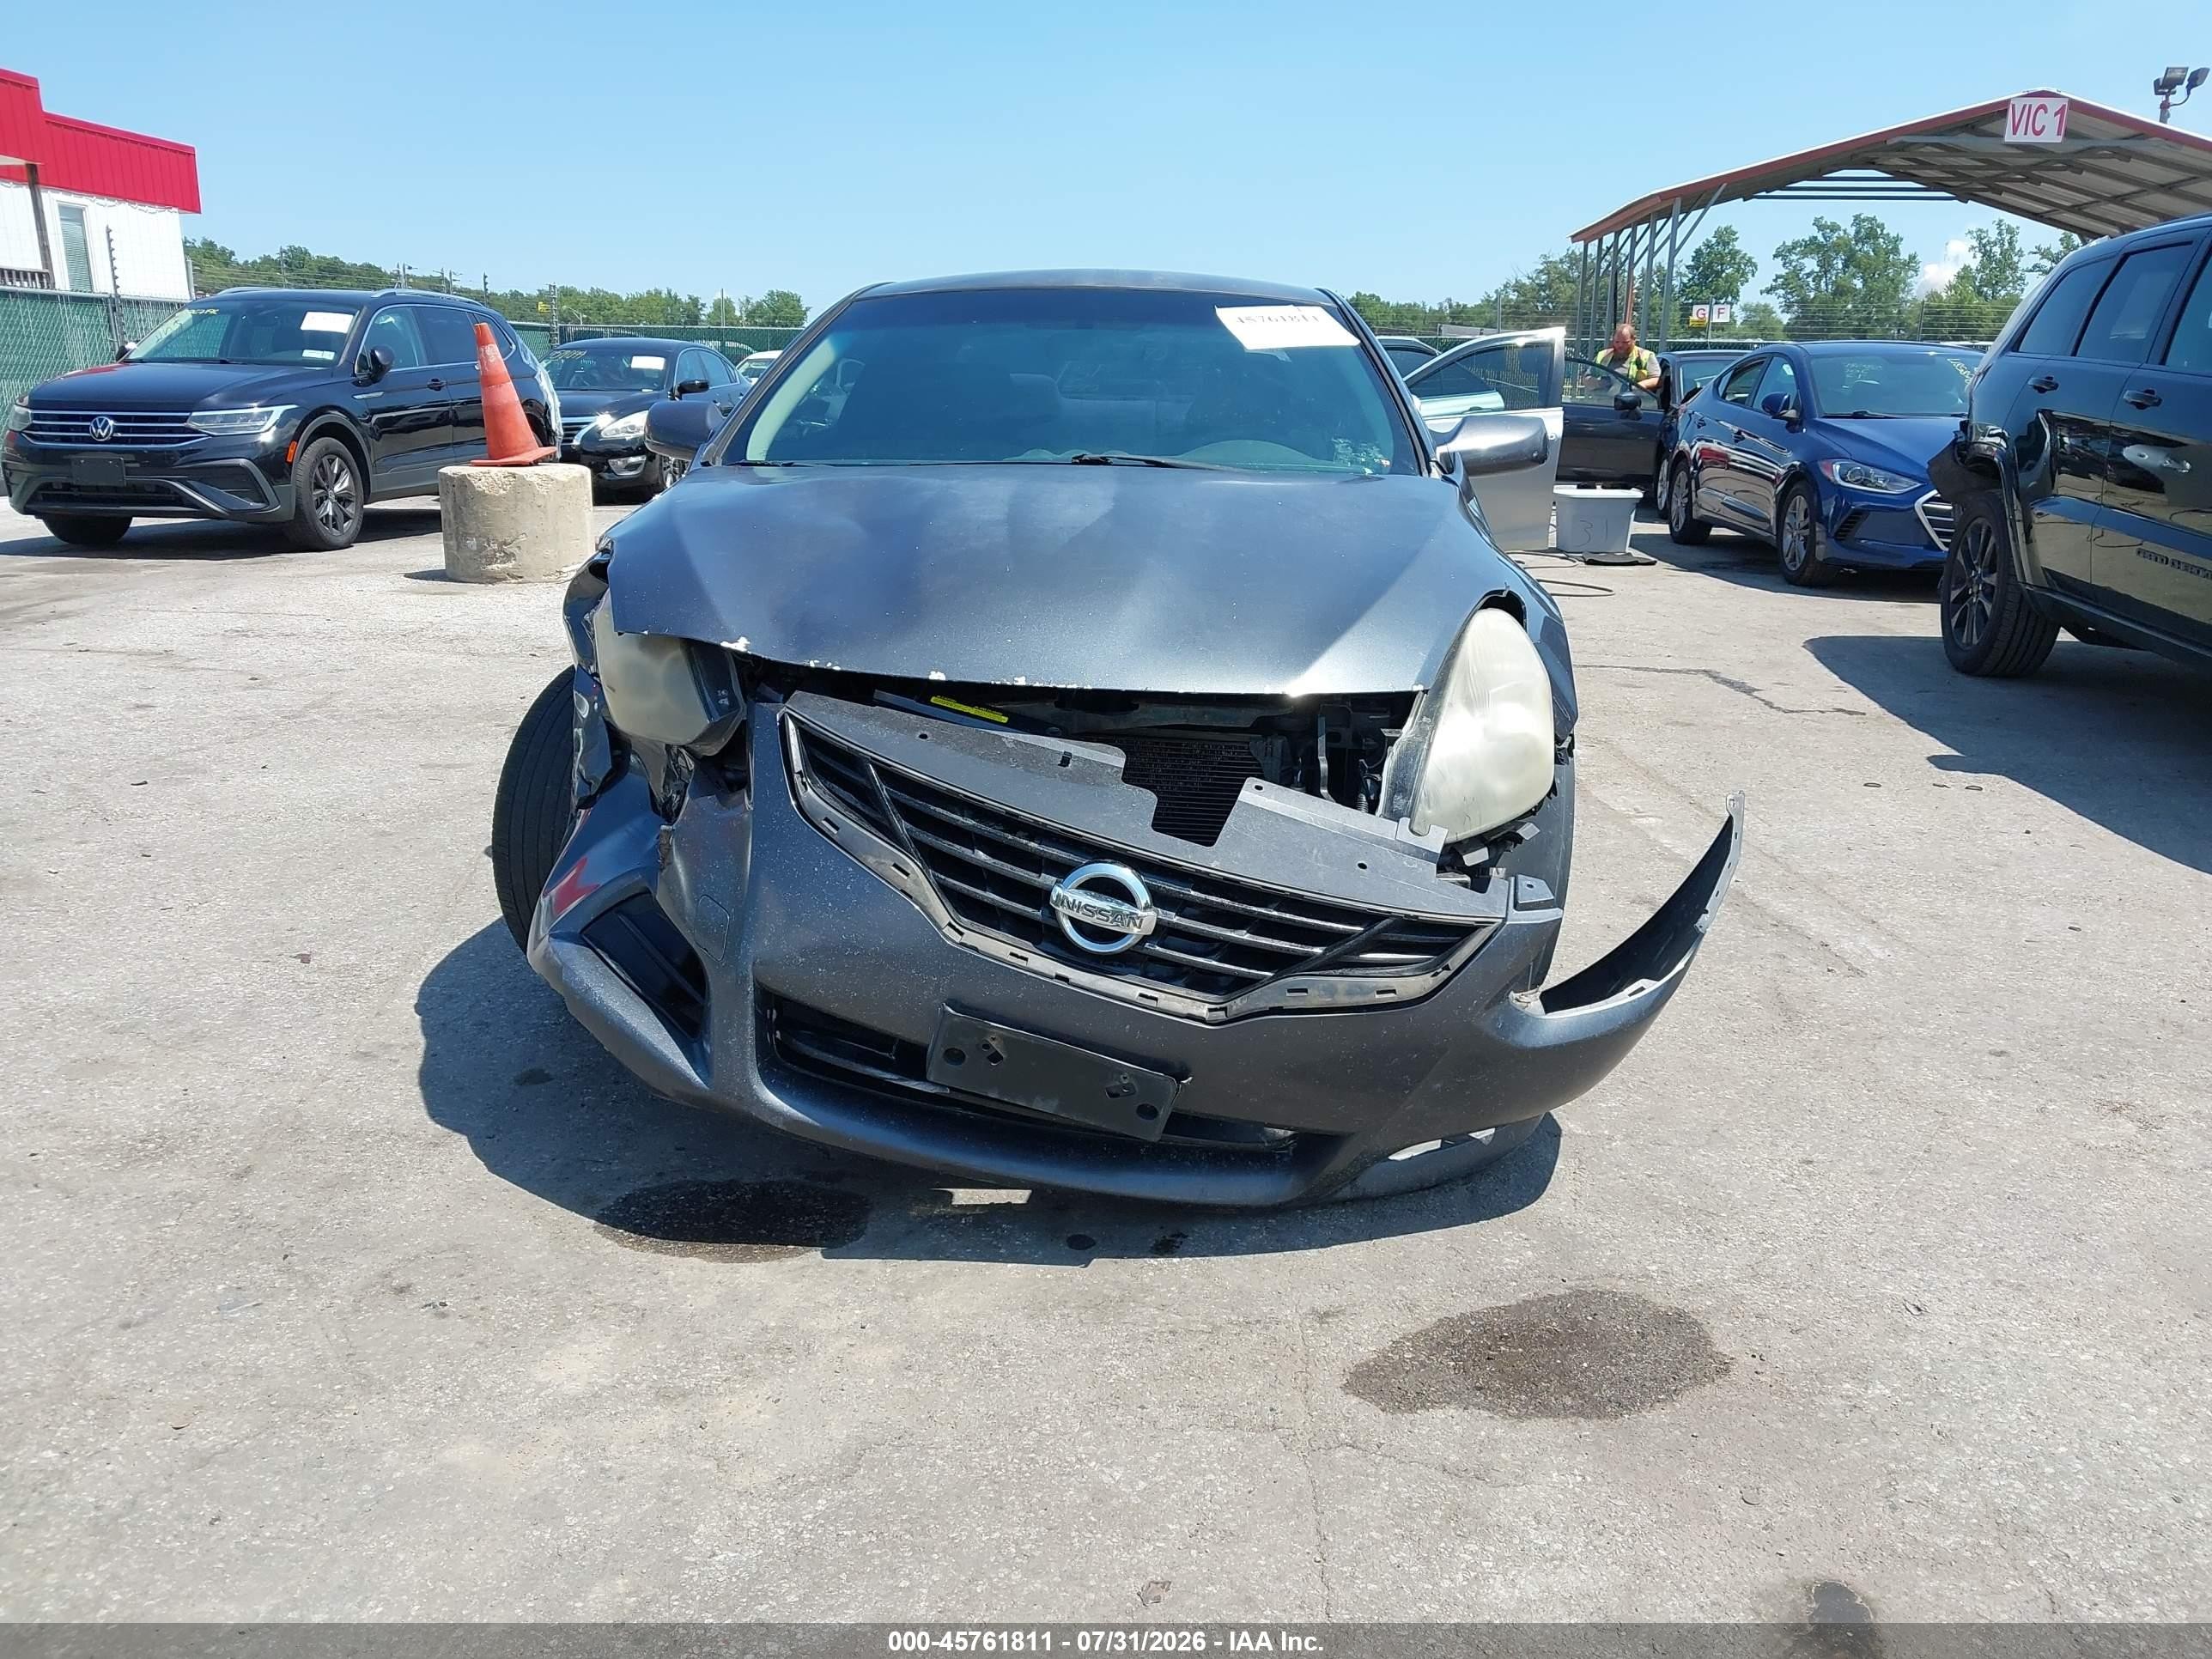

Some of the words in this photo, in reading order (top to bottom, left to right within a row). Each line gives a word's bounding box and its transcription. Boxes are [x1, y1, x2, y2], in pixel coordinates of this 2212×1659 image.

[2011, 103, 2048, 137] VIC
[2053, 103, 2067, 137] 1
[1696, 307, 1706, 319] G
[1717, 307, 1726, 319] F
[1574, 517, 1608, 547] 31
[1059, 893, 1144, 930] NISSAN
